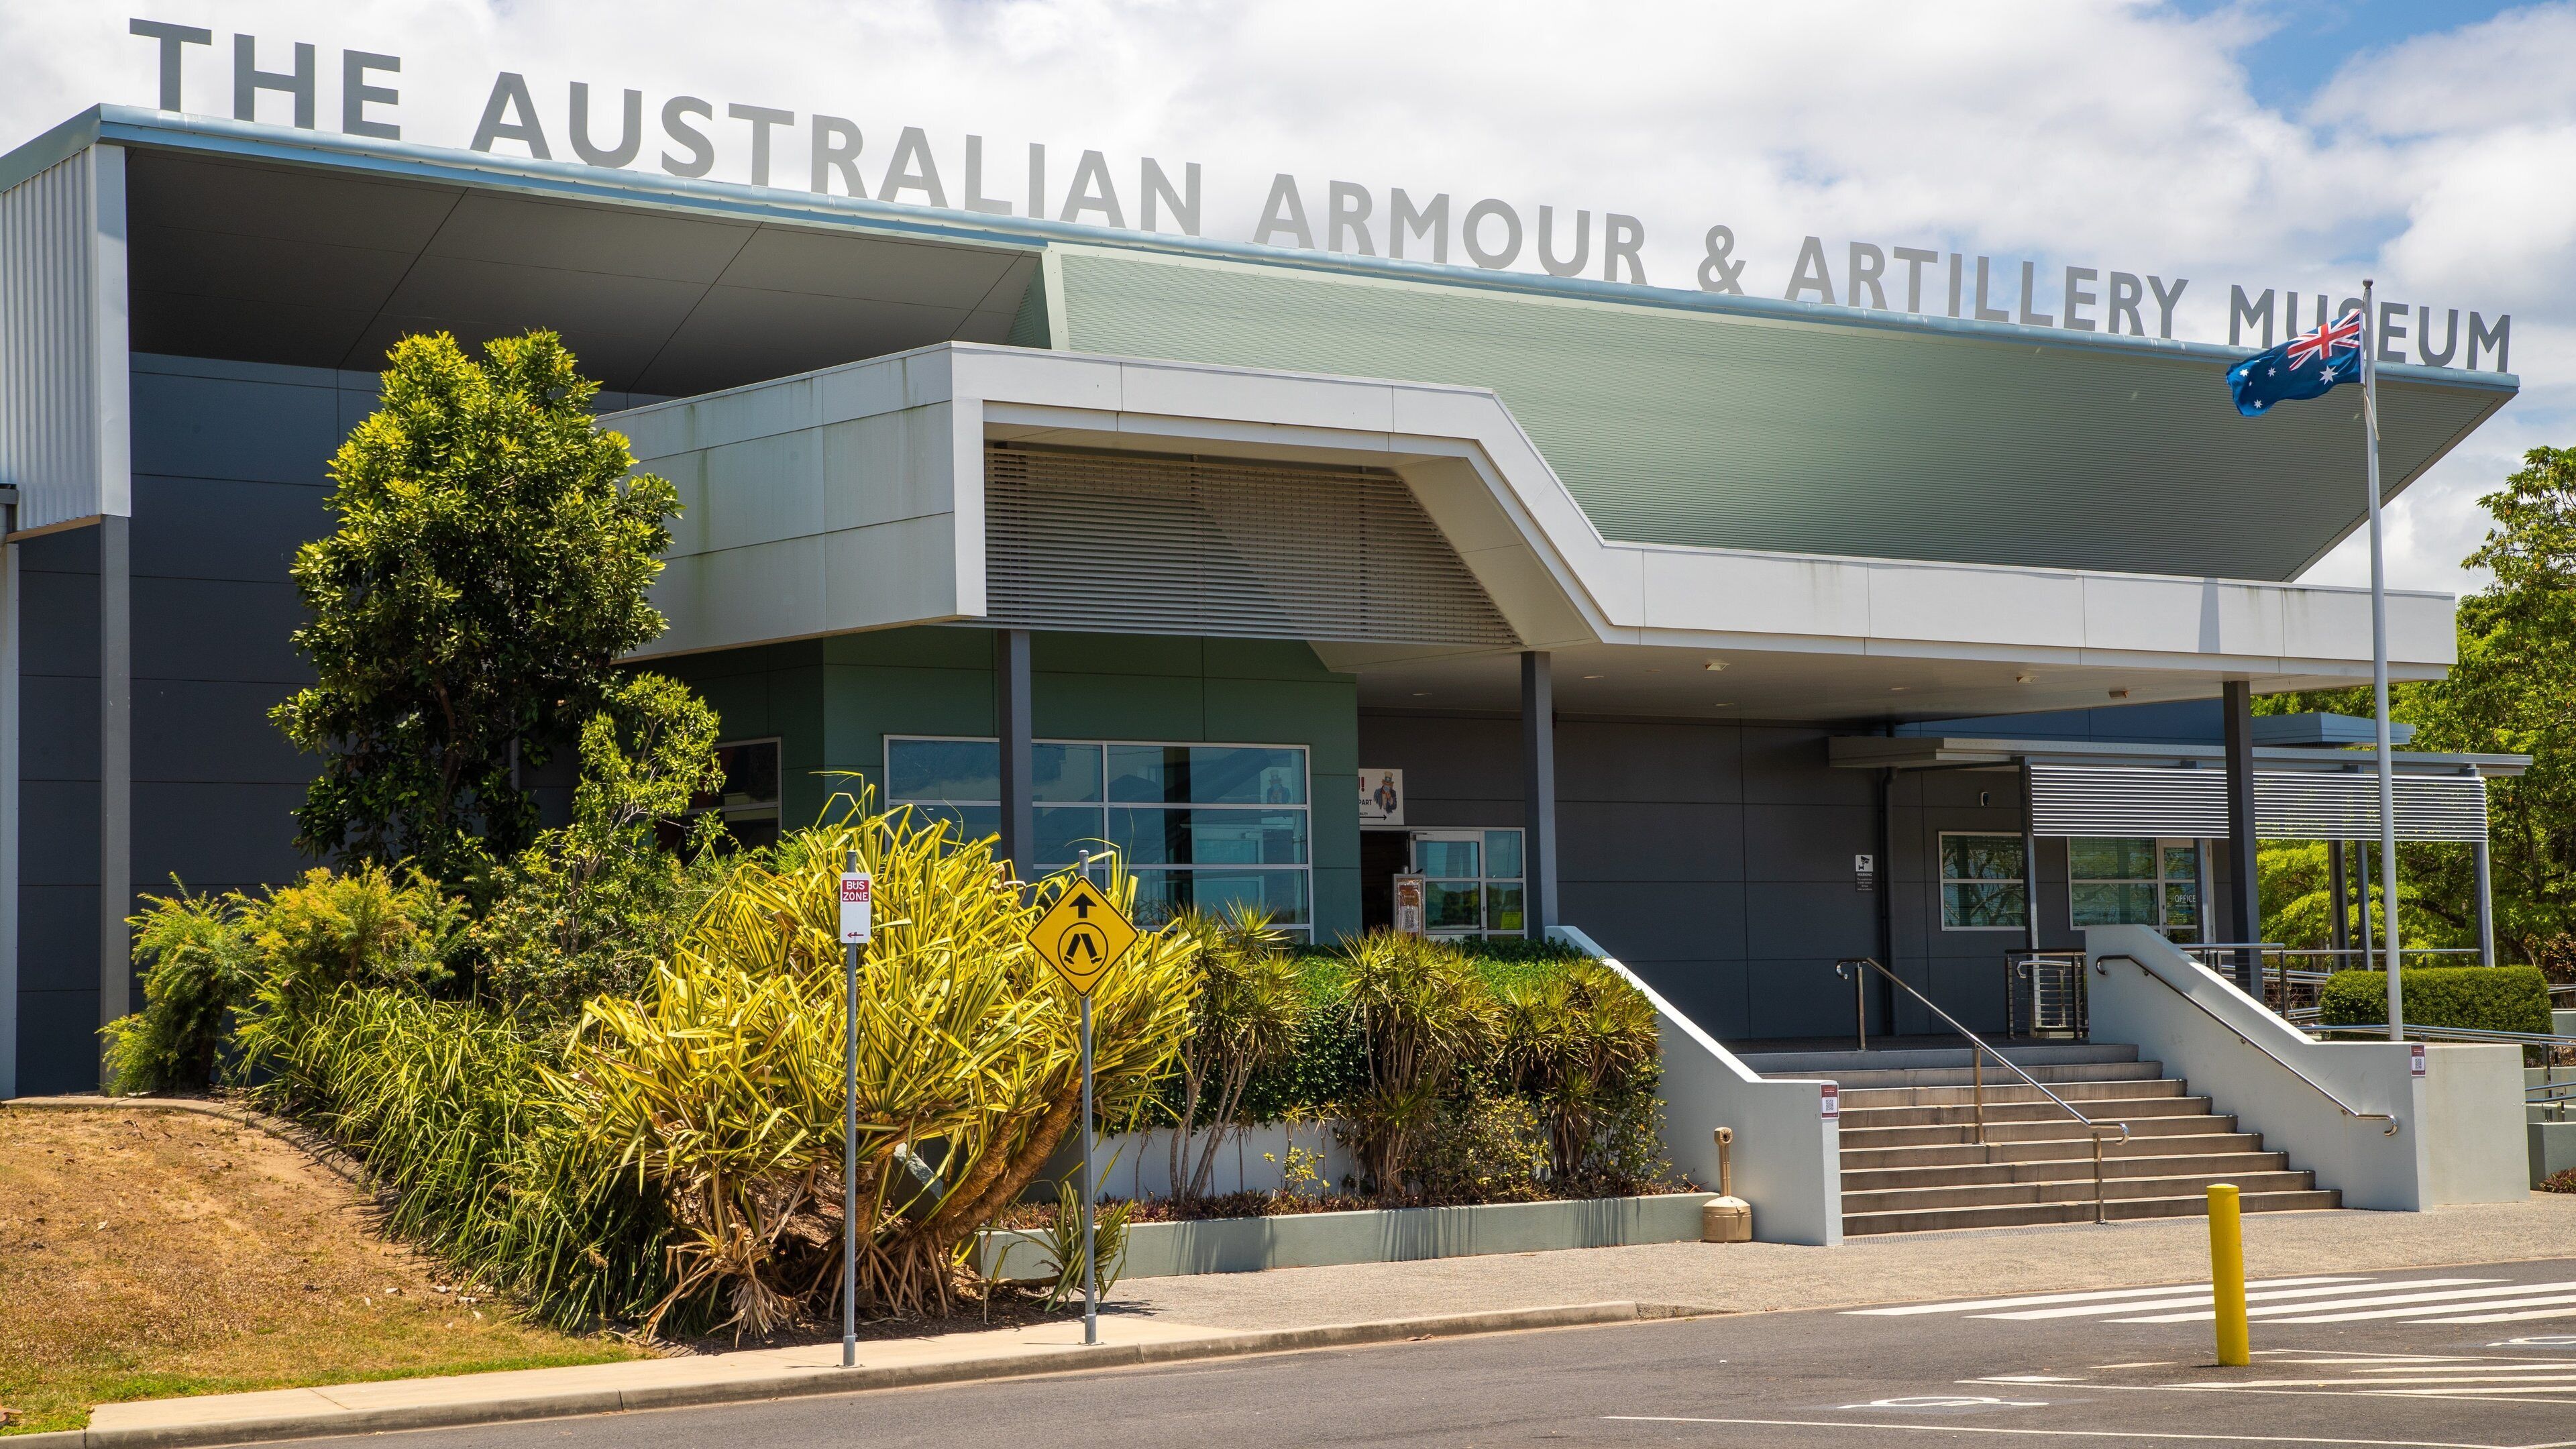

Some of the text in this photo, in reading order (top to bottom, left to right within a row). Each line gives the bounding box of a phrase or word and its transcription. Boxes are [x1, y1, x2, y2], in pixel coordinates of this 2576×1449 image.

[129, 17, 2511, 373] THE AUSTRALIAN ARMOUR & ARTILLERY MUEUM
[846, 881, 865, 890] BUS
[843, 892, 868, 901] ZONE
[2174, 894, 2196, 902] OFFICE
